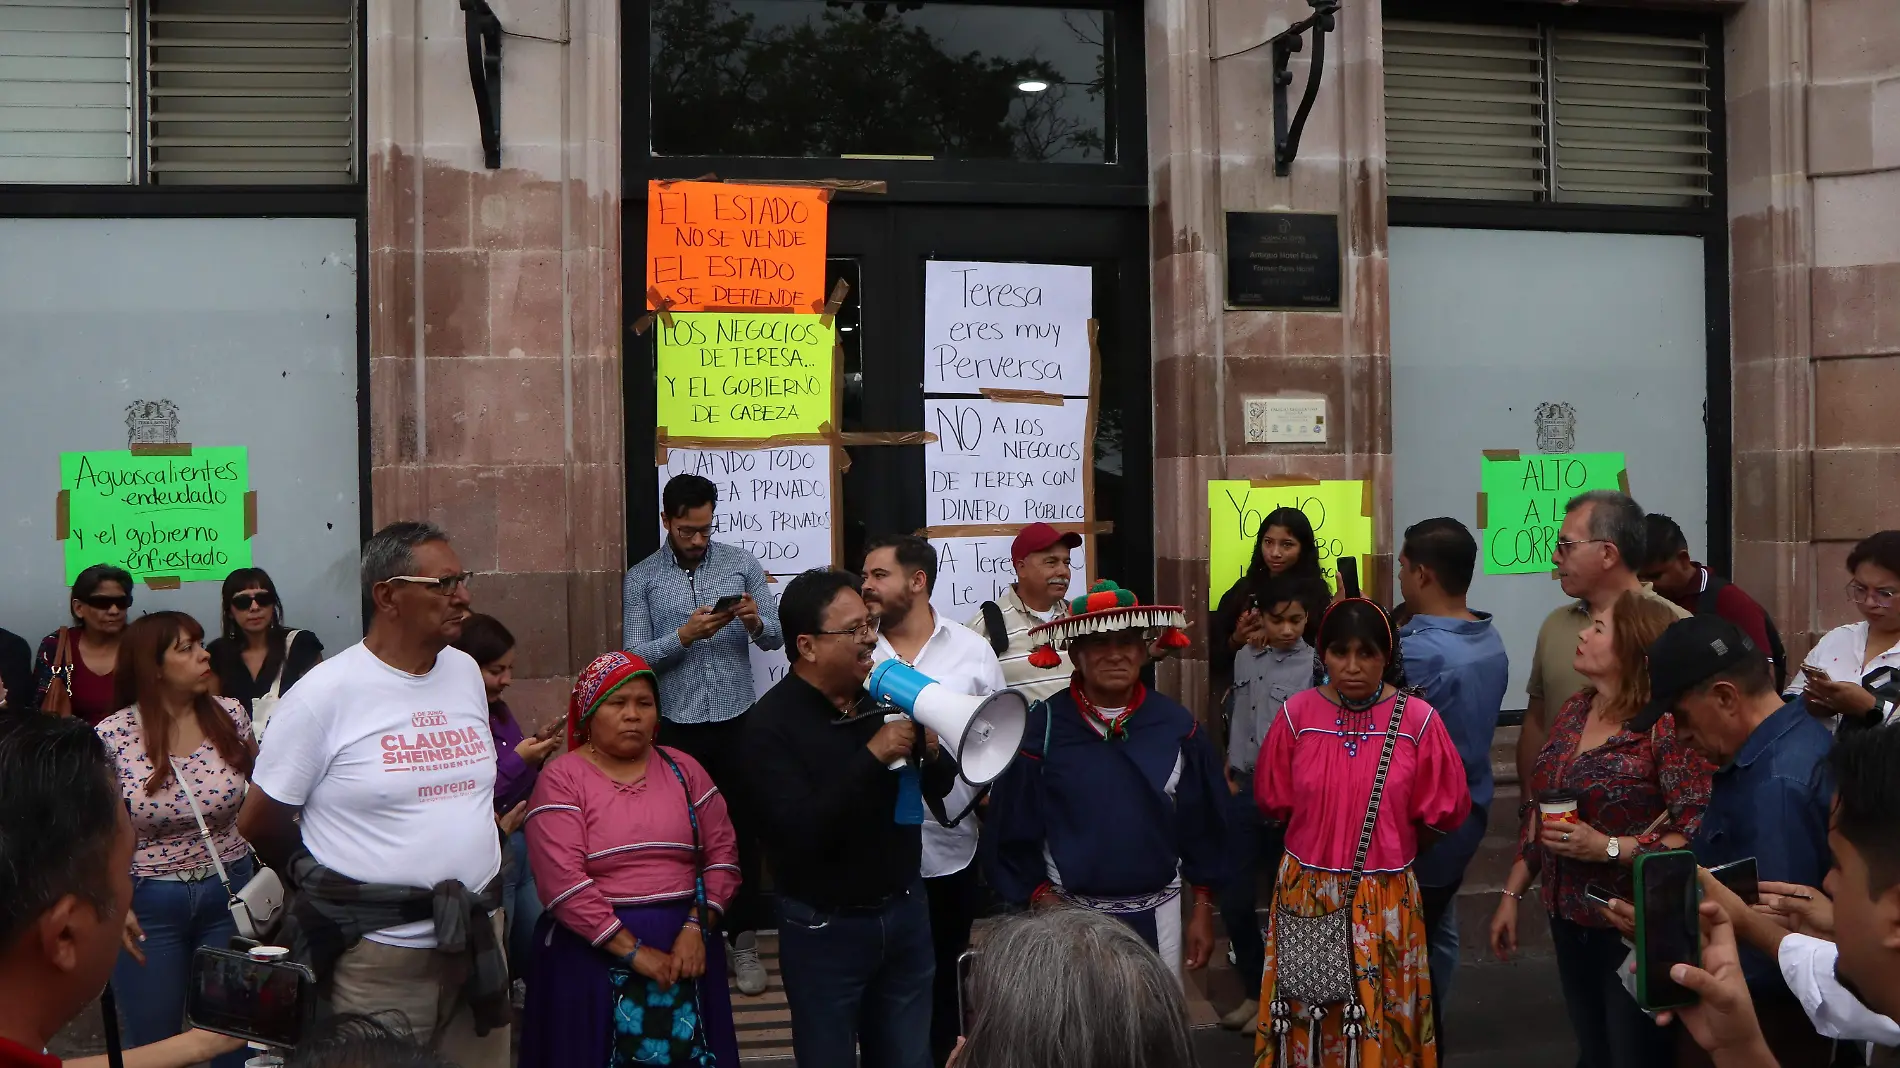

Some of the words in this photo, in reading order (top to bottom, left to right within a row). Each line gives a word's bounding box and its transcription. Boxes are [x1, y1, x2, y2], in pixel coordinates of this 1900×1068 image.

[658, 193, 697, 225] EL
[713, 193, 809, 225] ESTADO
[675, 227, 704, 247] NO
[707, 228, 734, 247] SE
[742, 229, 807, 248] VENDE
[653, 255, 699, 284] EL
[705, 255, 795, 281] ESTADO
[676, 287, 702, 305] SE
[712, 286, 806, 306] DEFIENDE
[951, 269, 1042, 308] Teresa
[662, 319, 706, 347] LOS
[716, 319, 819, 345] NEGOCIOS
[950, 322, 1004, 341] eres
[1016, 323, 1061, 347] muy
[700, 348, 726, 368] DE
[933, 344, 1063, 381] Perversa
[664, 375, 676, 398] Y
[689, 376, 715, 398] EL
[722, 374, 821, 398] GOBIERNO
[690, 403, 720, 424] DE
[730, 403, 800, 421] CABEZA
[937, 405, 982, 452] NO
[993, 417, 1006, 434] A
[1015, 418, 1044, 436] LOS
[1004, 441, 1080, 461] NEGOCIOS
[74, 455, 238, 496] Aguascalientes
[667, 449, 755, 479] CUANDO
[768, 449, 815, 472] TODO
[1521, 459, 1587, 491] ALTO
[712, 481, 742, 502] EA
[932, 470, 960, 493] DE
[971, 471, 1034, 488] TERESA
[1042, 468, 1076, 486] CON
[120, 483, 228, 506] endeudado
[770, 510, 831, 532] PRIVADOS
[941, 498, 1010, 522] DINERO
[1024, 499, 1085, 519] PÚBLICO
[1523, 499, 1541, 525] A
[1553, 496, 1572, 522] L
[94, 524, 117, 546] el
[126, 521, 218, 552] gobierno
[120, 546, 228, 571] enfiestado
[734, 539, 800, 560] TODO
[938, 542, 958, 573] A
[952, 582, 978, 606] Le
[412, 715, 447, 727] VOTA
[381, 726, 480, 751] CLAUDIA
[383, 741, 487, 764] SHEINBAUM
[412, 759, 475, 772] PRESIDENTA
[418, 780, 476, 797] morena
